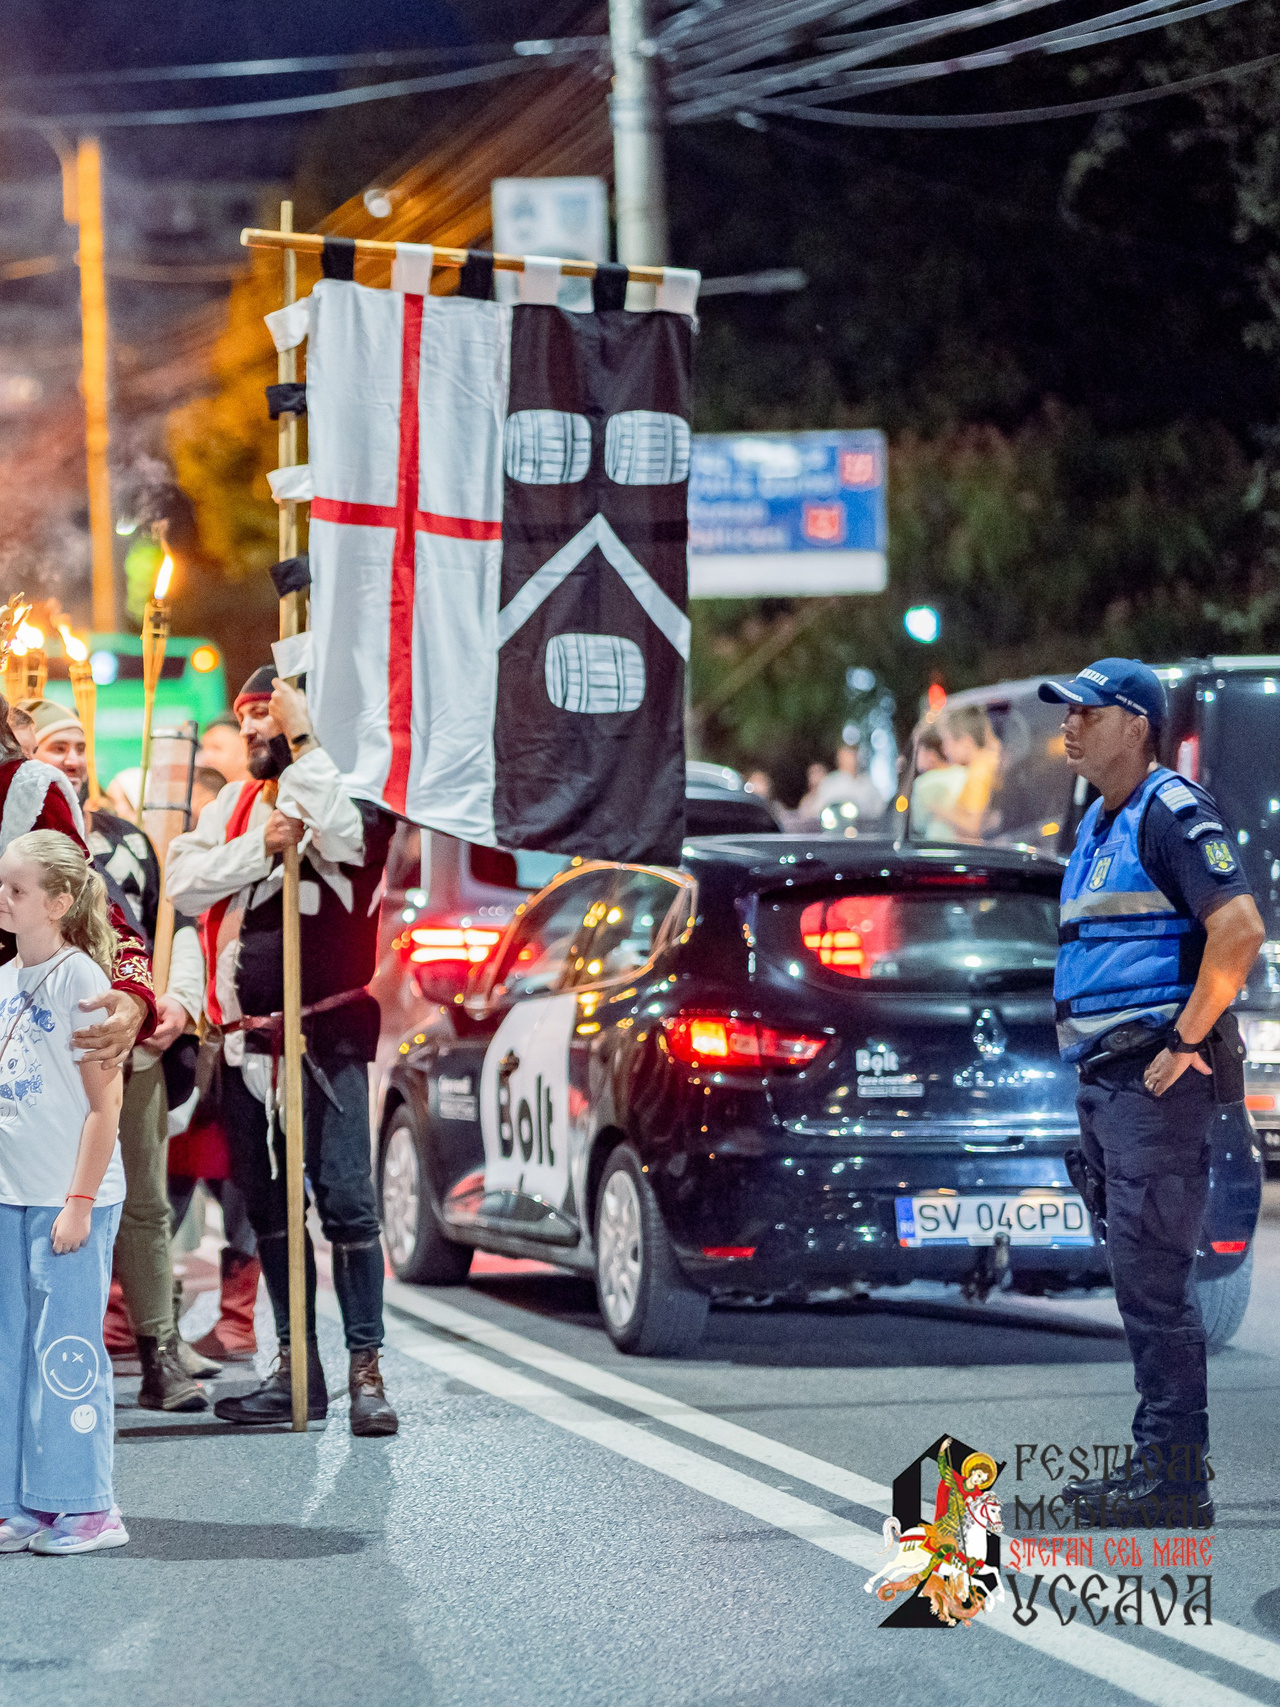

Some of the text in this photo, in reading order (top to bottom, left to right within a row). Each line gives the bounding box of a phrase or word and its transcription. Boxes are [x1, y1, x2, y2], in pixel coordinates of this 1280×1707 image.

[855, 1050, 899, 1073] Bolt
[496, 1068, 555, 1167] Bolt
[918, 1203, 961, 1232] SV
